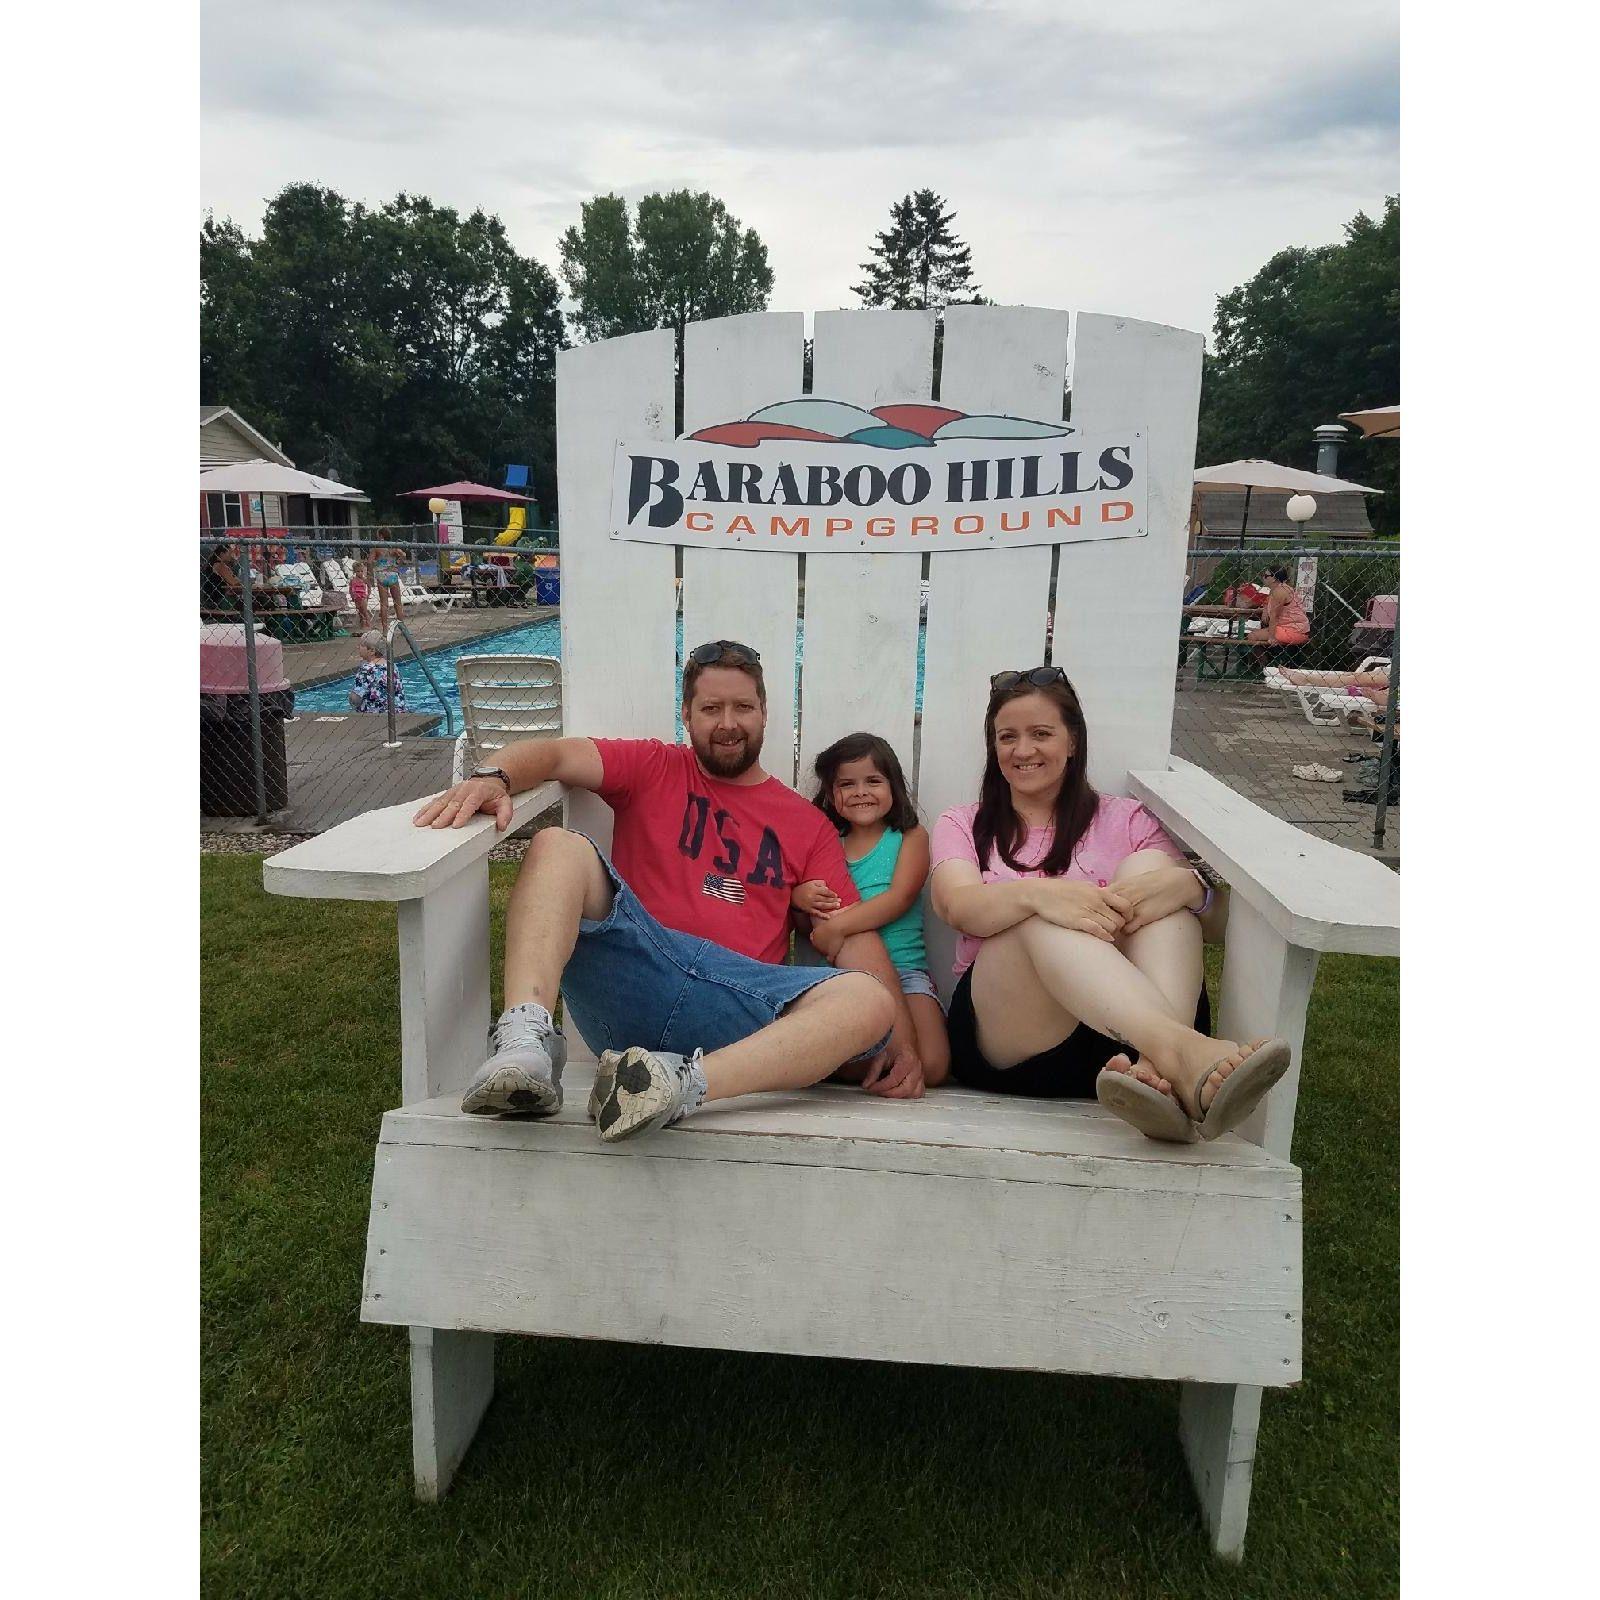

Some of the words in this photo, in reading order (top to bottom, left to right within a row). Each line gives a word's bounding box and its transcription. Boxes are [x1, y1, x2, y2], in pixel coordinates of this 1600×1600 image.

[628, 454, 932, 528] BARABOO
[946, 446, 1134, 502] HILLS
[685, 501, 1135, 536] CAMPGROUND
[679, 791, 786, 888] USA
